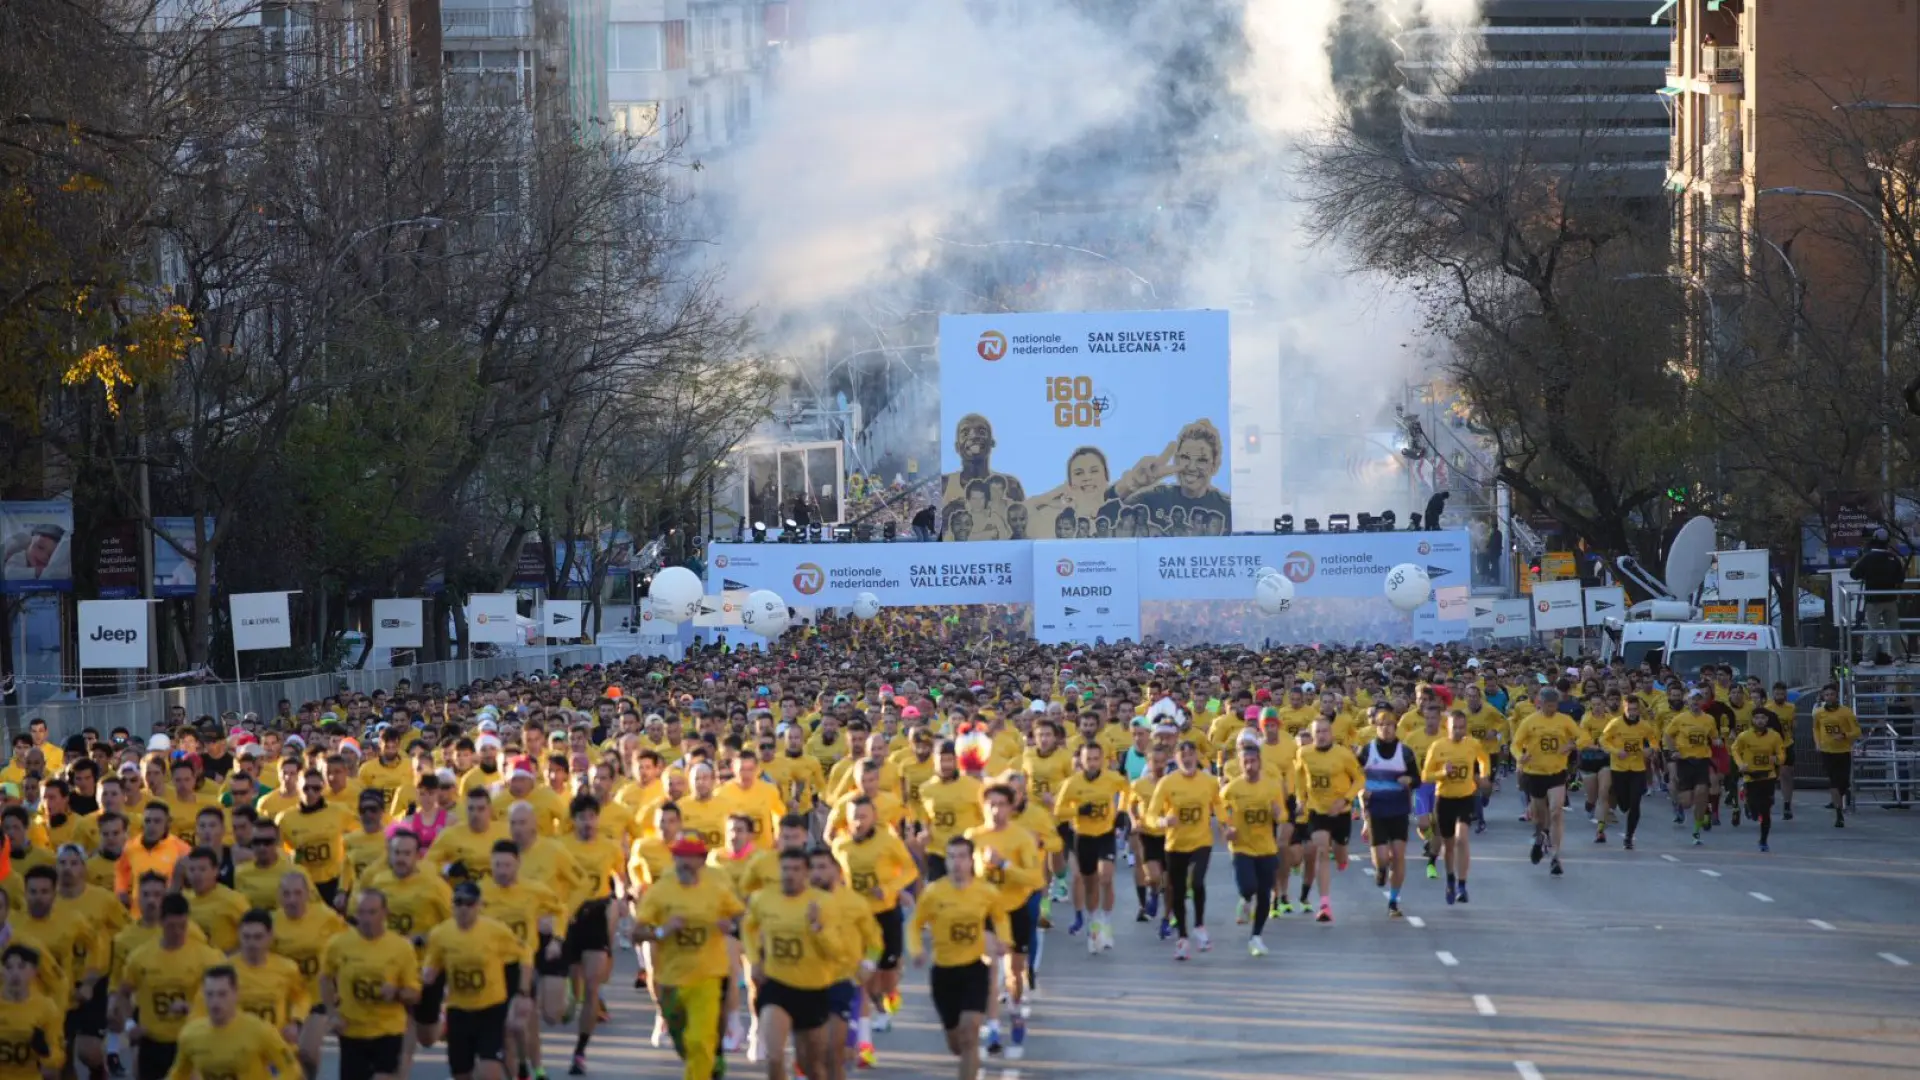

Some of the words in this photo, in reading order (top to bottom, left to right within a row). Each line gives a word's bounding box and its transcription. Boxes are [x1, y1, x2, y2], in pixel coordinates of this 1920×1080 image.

[1012, 334, 1061, 344] nationale
[1088, 332, 1114, 343] SAN
[1118, 331, 1186, 342] SILVESTRE
[1012, 344, 1079, 354] nederlanden
[1088, 343, 1161, 353] VALLECANA
[1172, 342, 1186, 353] 24
[1159, 556, 1185, 567] SAN
[1190, 554, 1262, 567] SILVESTRE
[1320, 552, 1373, 565] nationale
[830, 566, 882, 578] nationale
[910, 564, 936, 576] SAN
[941, 562, 1012, 575] SILVESTRE
[1159, 567, 1236, 580] VALLECANA
[1320, 564, 1391, 576] nederlanden
[830, 578, 900, 589] nederlanden
[910, 575, 986, 588] VALLECANA
[997, 575, 1012, 586] 24
[1061, 586, 1112, 598] MADRID
[90, 625, 138, 645] Jeep
[1541, 737, 1559, 752] 60
[1179, 807, 1202, 824] 60
[1244, 809, 1268, 826] 60
[305, 843, 331, 863] 60
[676, 926, 707, 948] 60
[950, 922, 978, 944] 60
[772, 936, 803, 961] 60
[453, 969, 486, 991] 60
